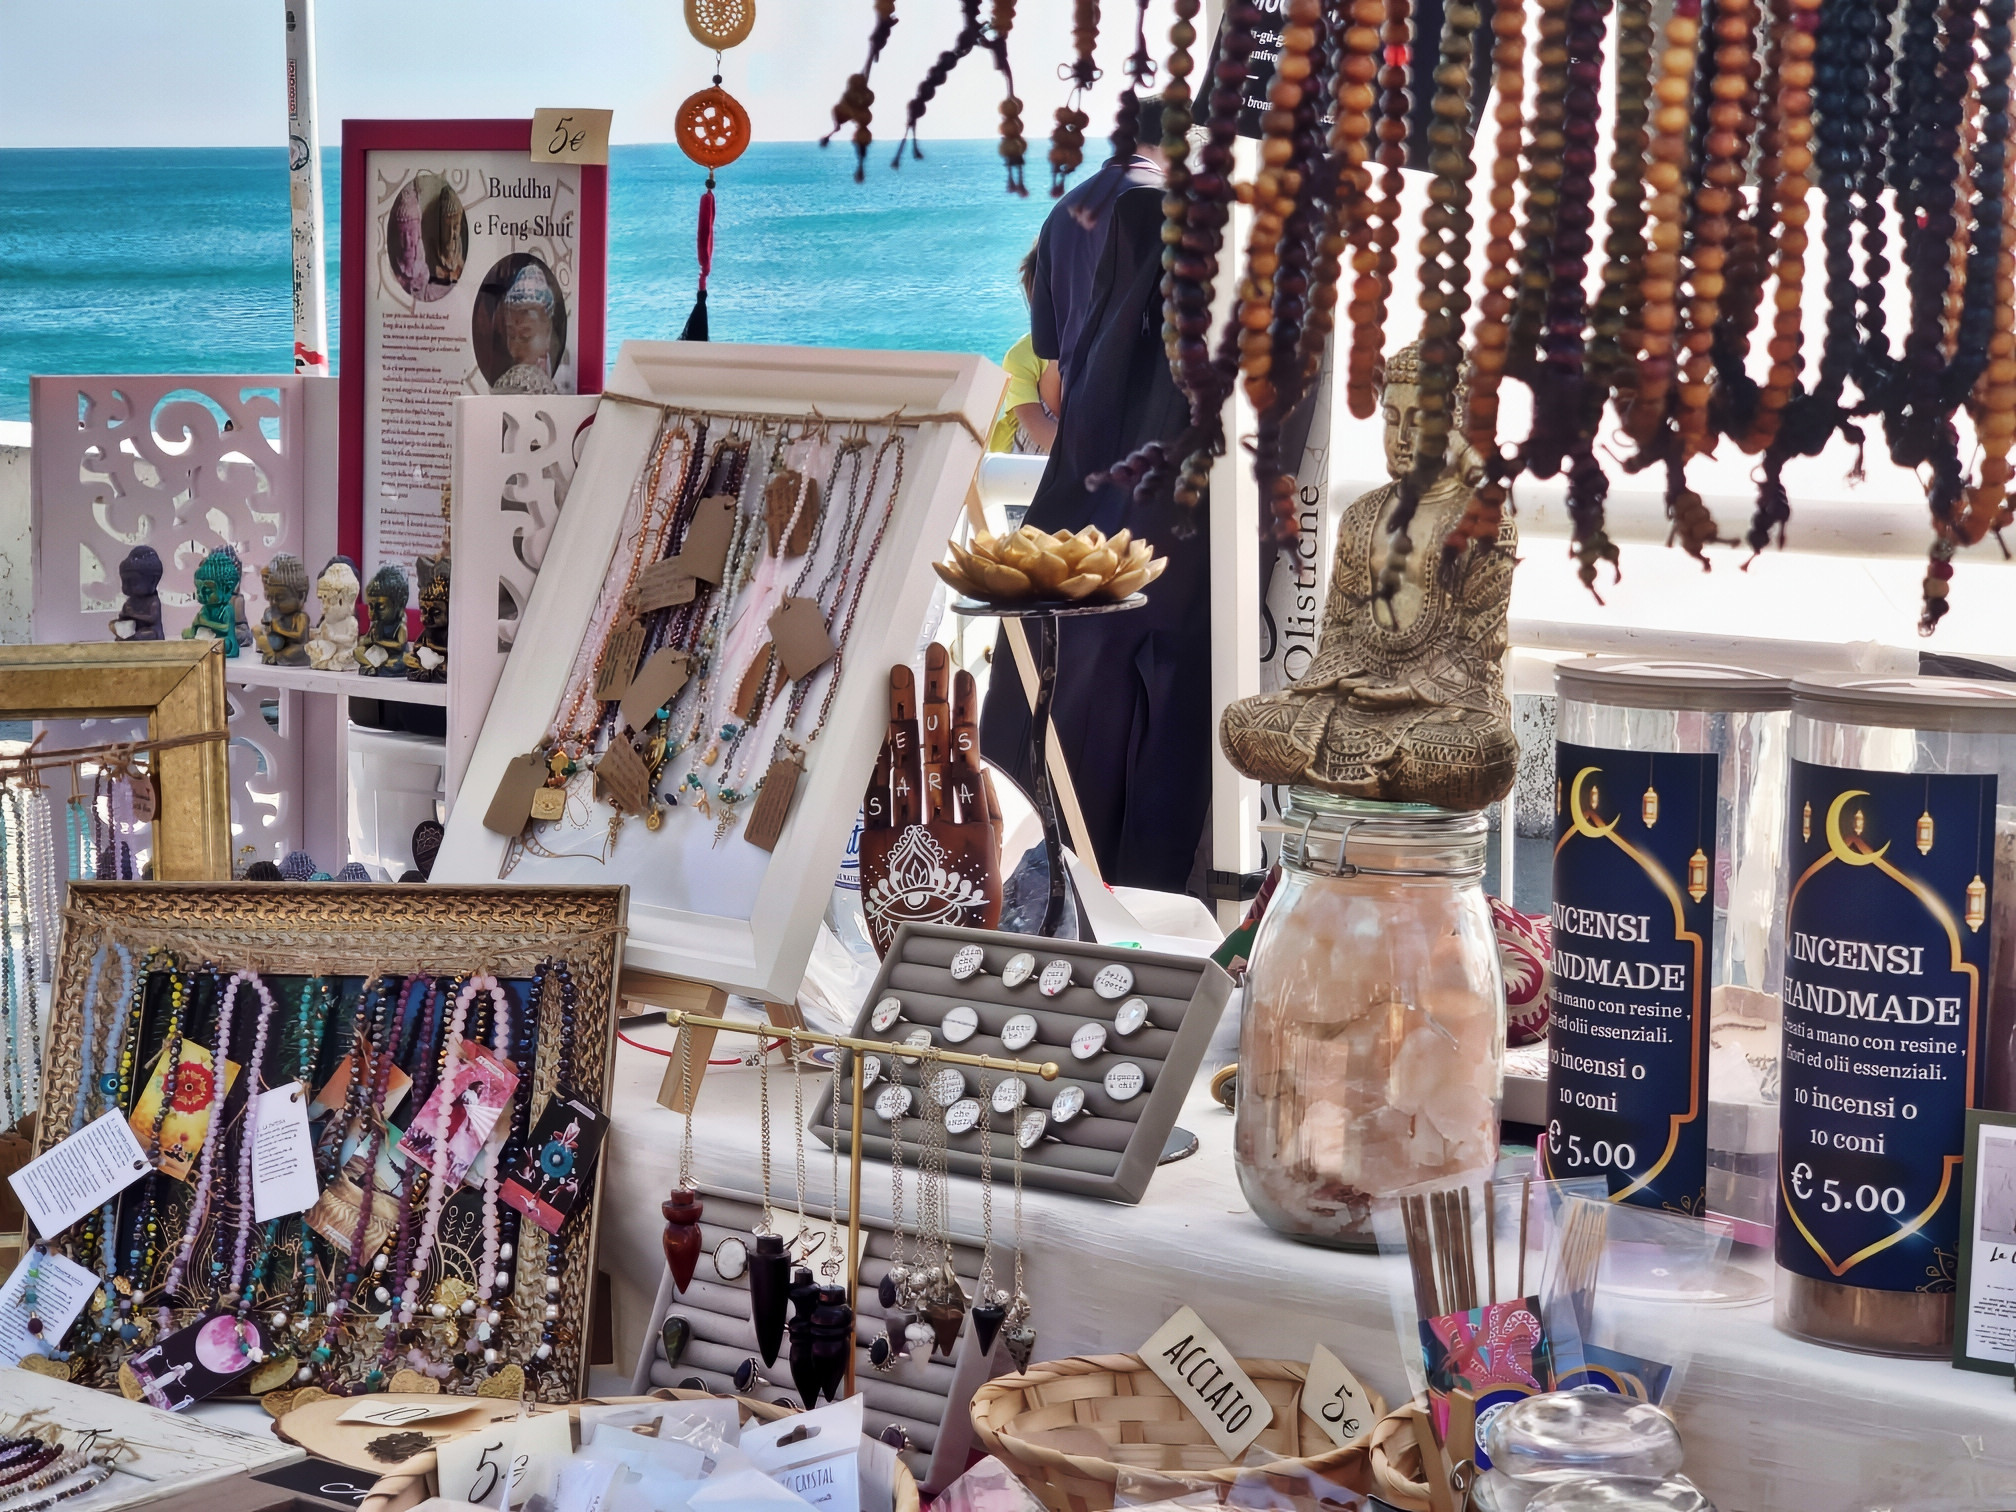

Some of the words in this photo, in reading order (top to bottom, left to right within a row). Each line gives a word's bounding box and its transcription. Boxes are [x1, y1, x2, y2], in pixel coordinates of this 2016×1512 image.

[548, 117, 587, 154] 5€
[489, 176, 552, 199] Buddha
[473, 221, 483, 235] e
[487, 214, 529, 241] Feng
[532, 214, 574, 239] Shui
[1283, 484, 1319, 682] Olistiche
[1550, 947, 1686, 992] ANDMADE
[1794, 931, 1925, 976] INCENSI
[1563, 994, 1596, 1011] mano
[1598, 1000, 1625, 1015] con
[1629, 1002, 1683, 1019] resine
[1784, 976, 1962, 1026] HANDMADE
[1569, 1017, 1588, 1036] olii
[1590, 1023, 1674, 1044] essenziali.
[1806, 1027, 1815, 1040] a
[1816, 1029, 1860, 1048] mano
[1862, 1037, 1896, 1052] con
[1900, 1038, 1958, 1055] resine
[1560, 1047, 1627, 1079] incensi
[1631, 1064, 1647, 1081] o
[1807, 1051, 1823, 1069] ed
[1824, 1054, 1849, 1073] olii
[1853, 1062, 1948, 1081] essenziali.
[1560, 1087, 1573, 1105] 10
[1575, 1092, 1619, 1113] coni
[1794, 1087, 1809, 1105] 10
[1811, 1086, 1897, 1120] incensi
[1901, 1103, 1918, 1120] o
[1567, 1135, 1637, 1170] 5.00
[1810, 1128, 1829, 1146] 10
[1833, 1133, 1886, 1155] coni
[1790, 1162, 1814, 1200] €
[1821, 1178, 1907, 1216] 5.00
[1162, 1334, 1253, 1434] ACCIAIO
[1321, 1384, 1360, 1439] 5€
[795, 1465, 835, 1494] CRYSTAL
